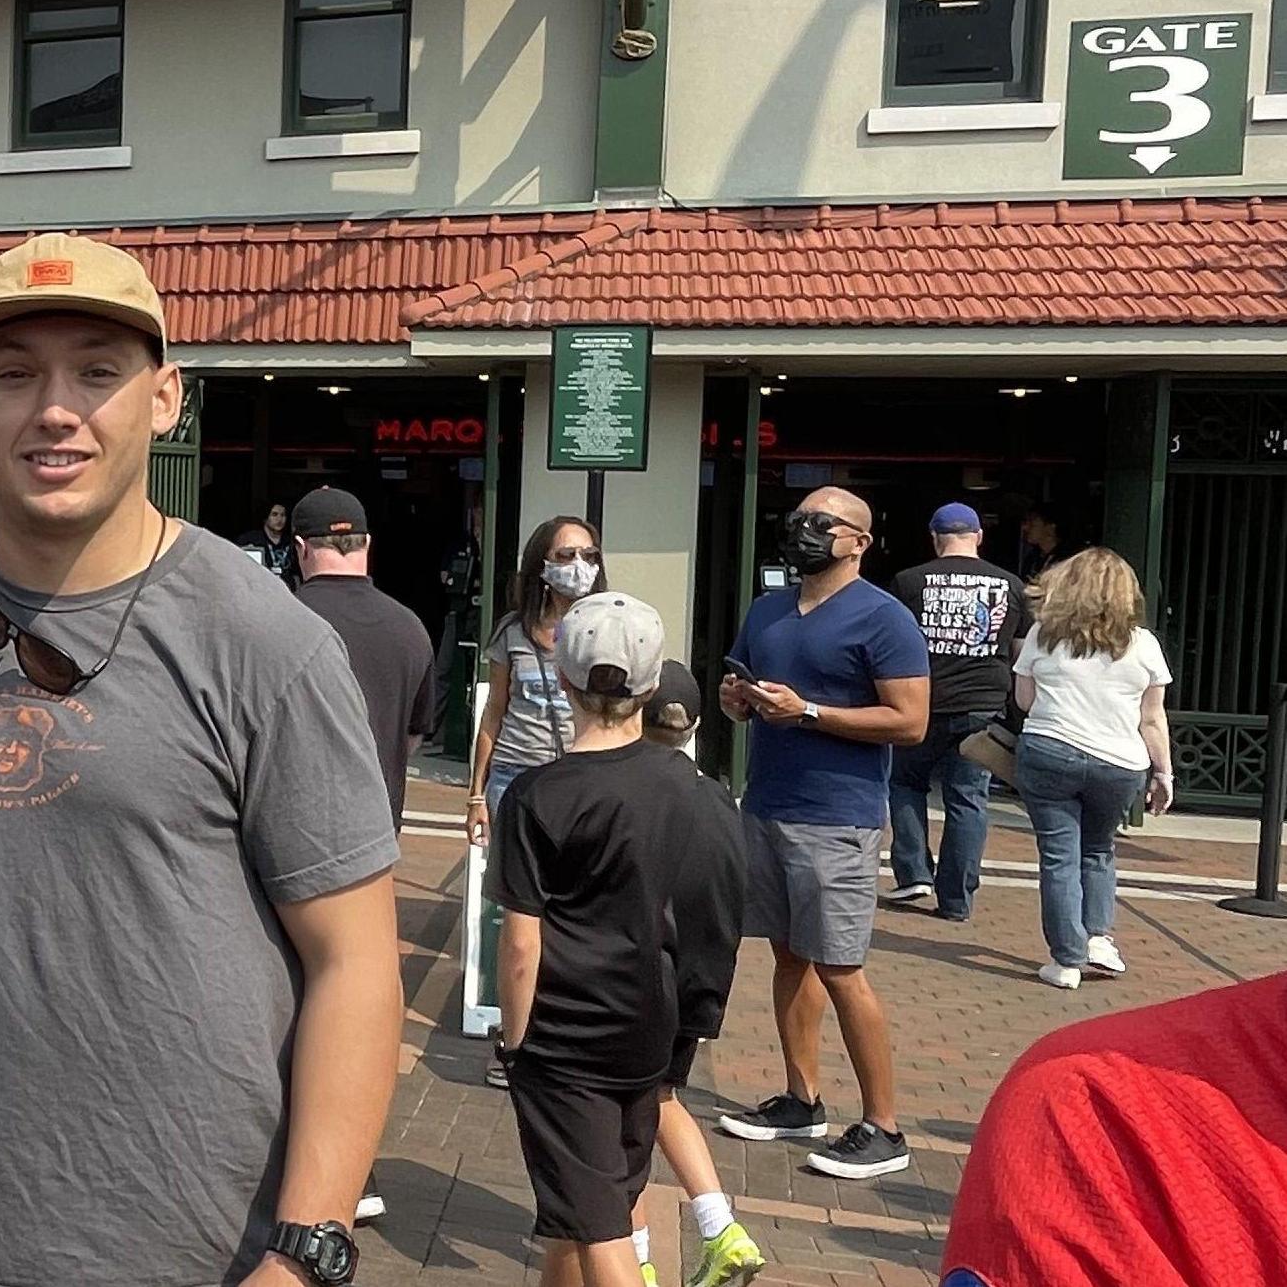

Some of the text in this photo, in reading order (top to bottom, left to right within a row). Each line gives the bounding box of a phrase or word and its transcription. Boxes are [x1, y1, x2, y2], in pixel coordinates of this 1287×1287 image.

[1082, 20, 1240, 55] GATE
[1098, 55, 1212, 144] 3
[377, 419, 484, 443] MARQ
